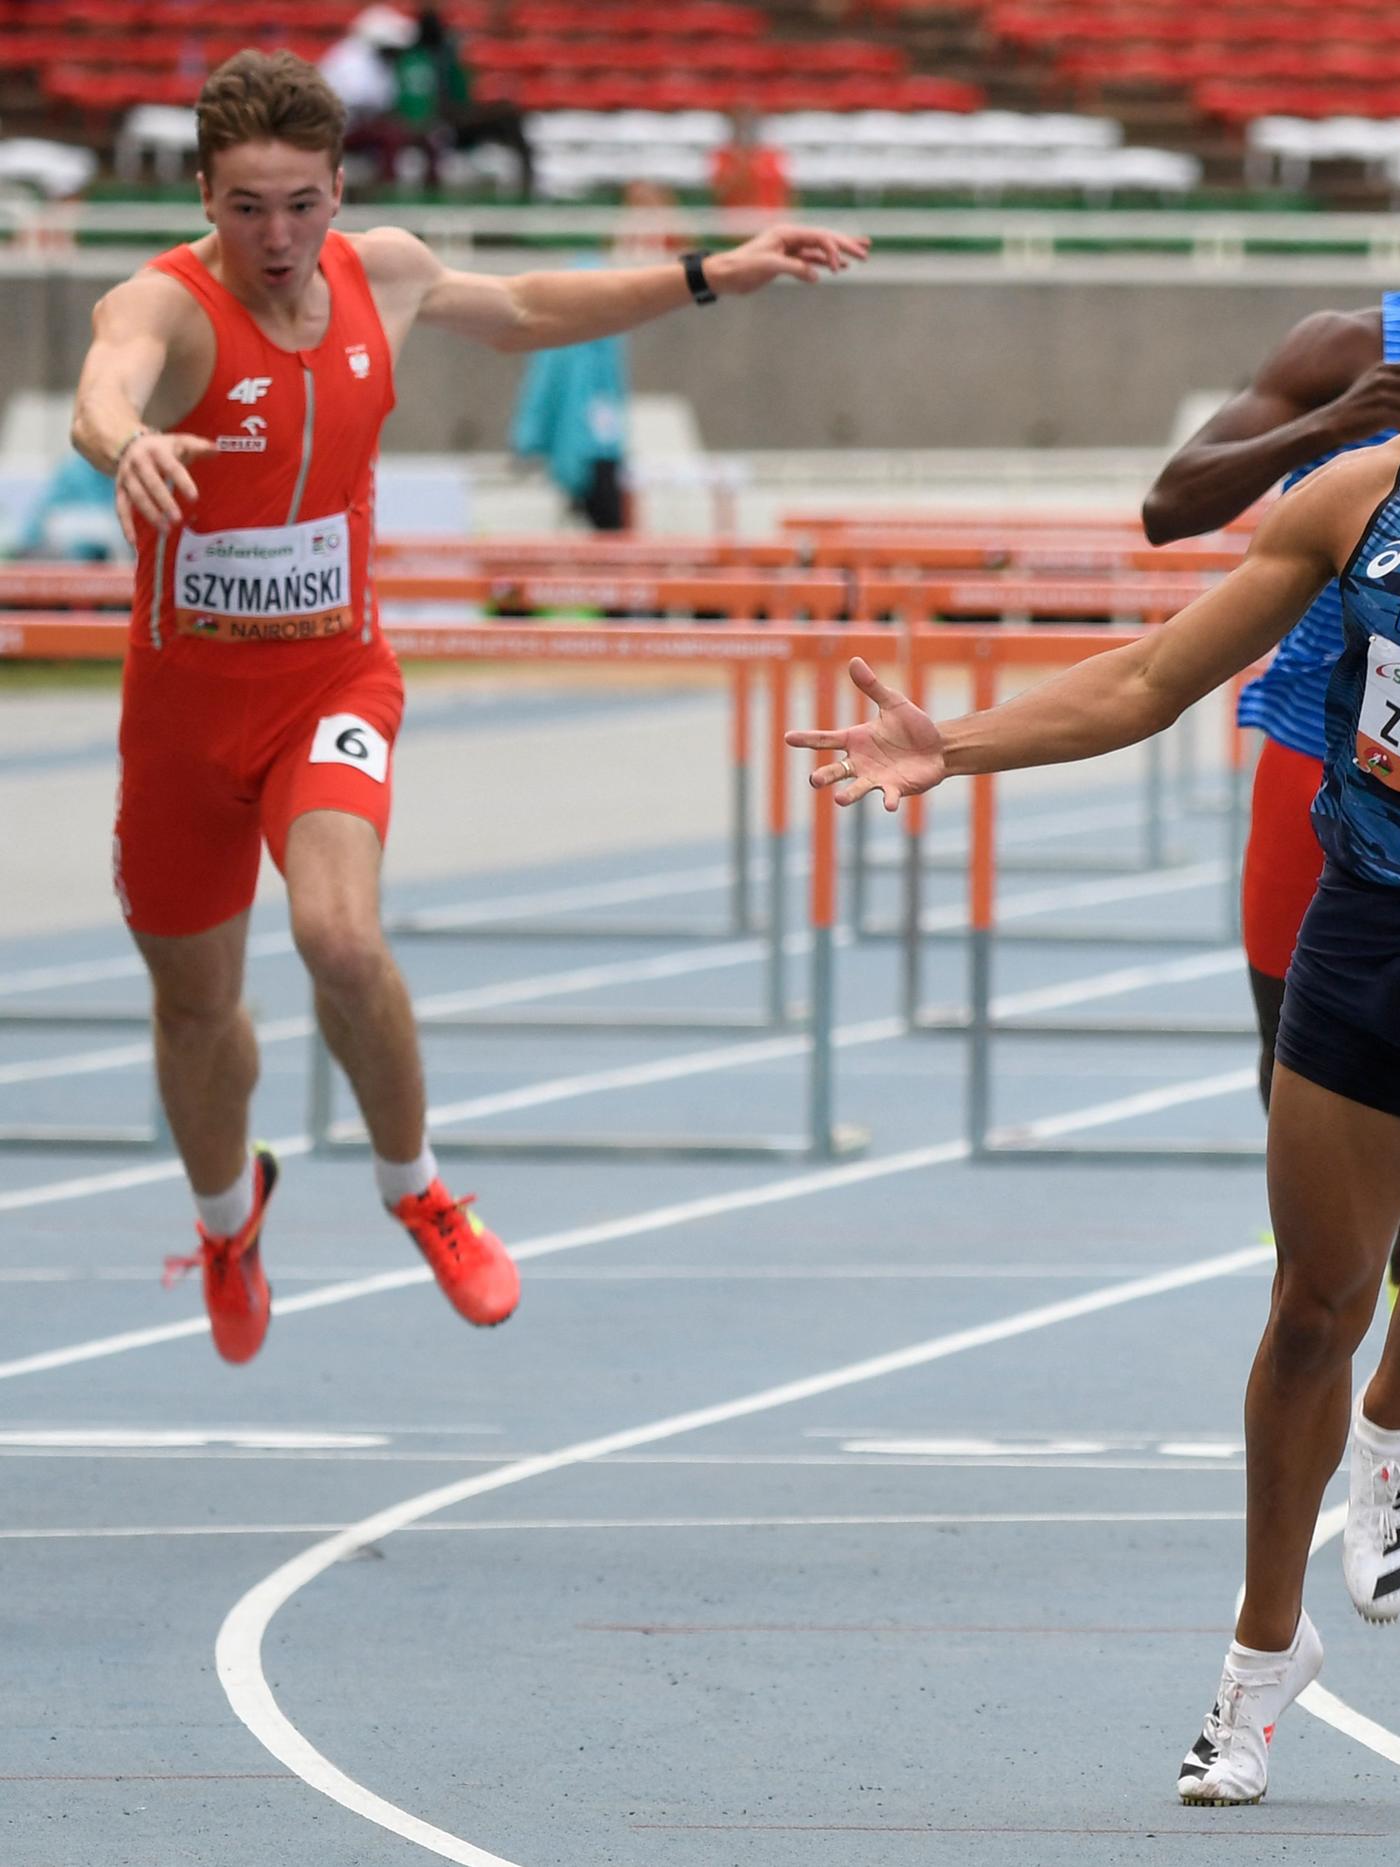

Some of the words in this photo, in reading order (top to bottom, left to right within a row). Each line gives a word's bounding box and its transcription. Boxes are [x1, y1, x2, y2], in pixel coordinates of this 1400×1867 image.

[227, 377, 273, 404] 4F
[219, 439, 263, 450] ORLEN
[184, 566, 341, 612] SZYMAŃSKI
[230, 619, 317, 640] NAIROBI
[324, 615, 342, 632] 21
[335, 727, 368, 759] 6
